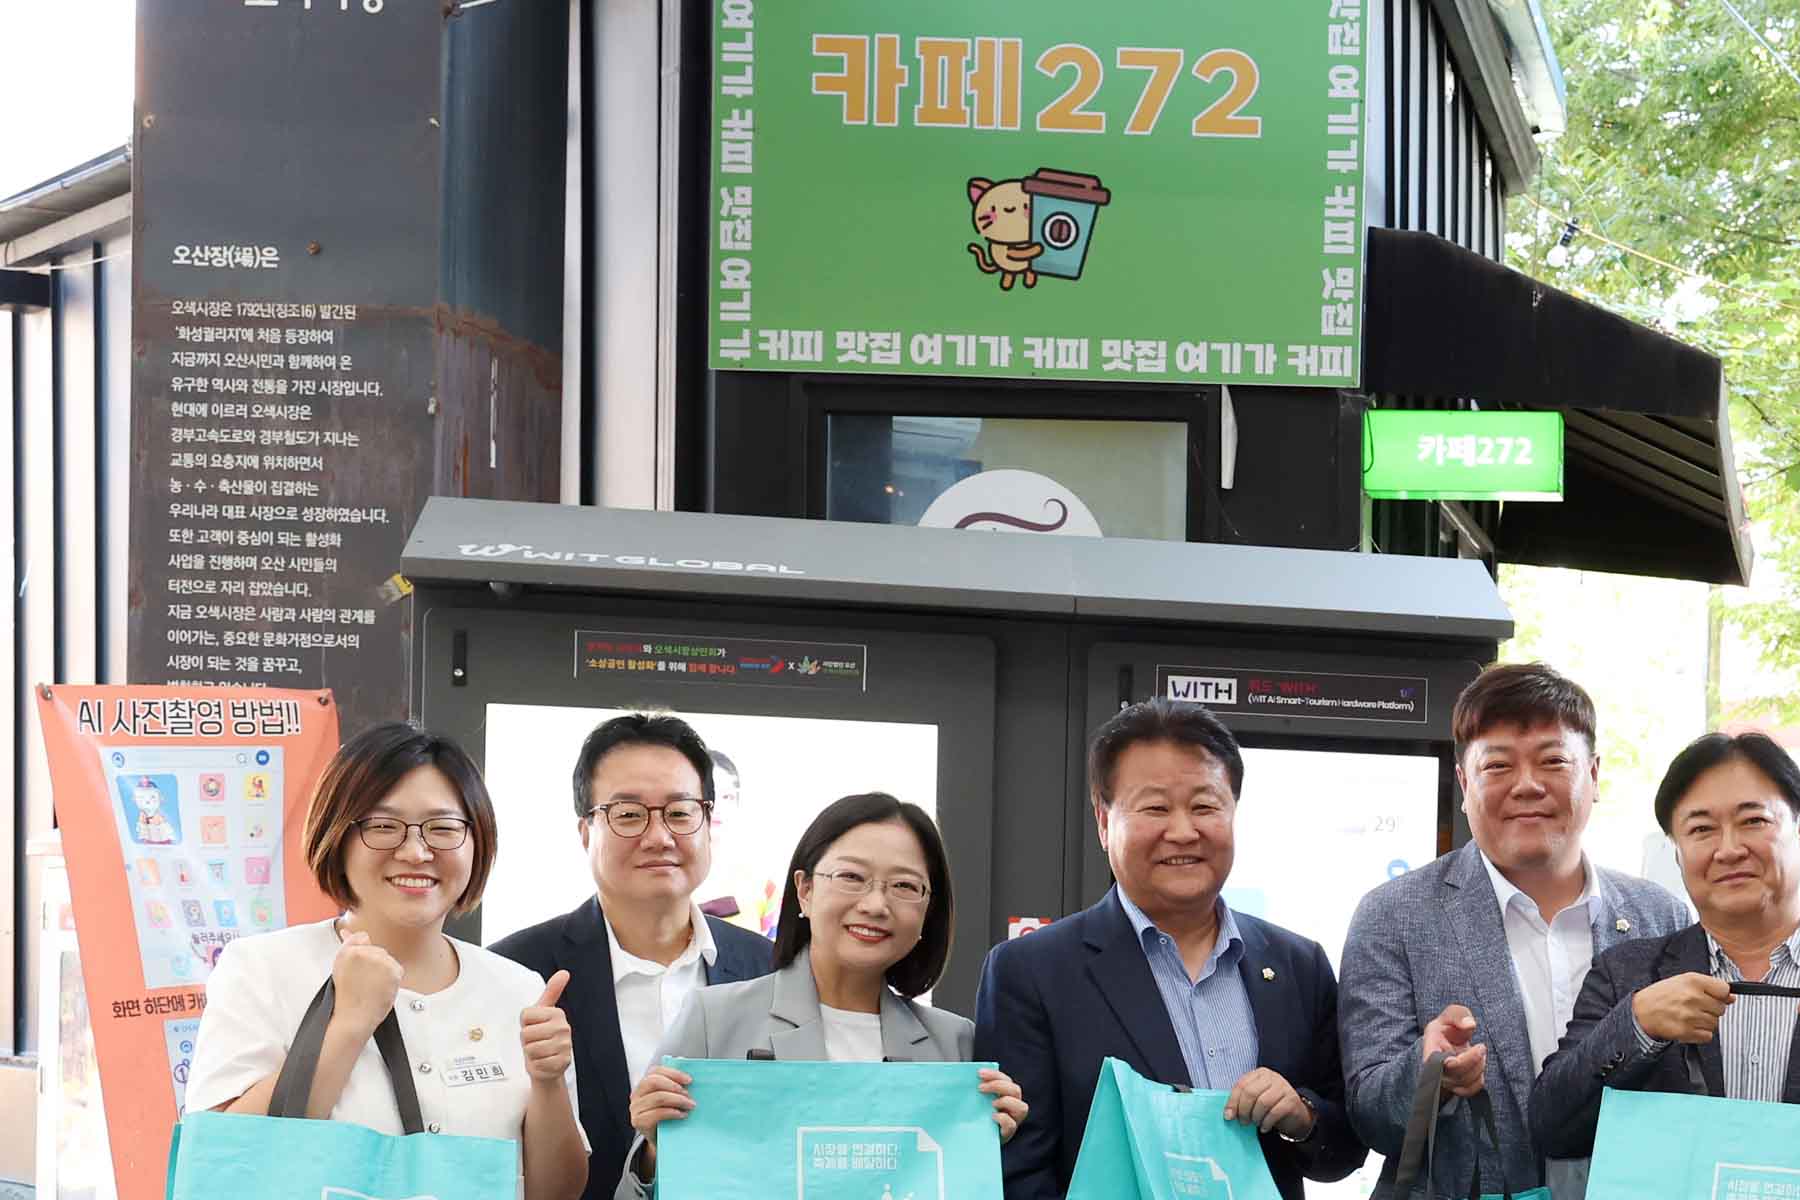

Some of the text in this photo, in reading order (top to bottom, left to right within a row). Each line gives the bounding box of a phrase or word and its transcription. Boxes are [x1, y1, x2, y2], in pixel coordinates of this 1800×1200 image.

[811, 33, 1262, 138] 카페272
[1327, 65, 1360, 173] 여기가
[721, 108, 753, 173] 커피
[720, 186, 752, 250] 맛집
[1323, 185, 1356, 254] 커피
[171, 300, 232, 317] 오색시장은
[320, 304, 356, 320] 발간된
[720, 258, 752, 360] 여기가
[1321, 268, 1355, 336] 맛집
[257, 328, 281, 343] 처음
[285, 329, 334, 344] 등장하여
[171, 352, 220, 367] 지금까지
[224, 353, 284, 369] 오산시민과
[288, 354, 336, 370] 함께하여
[758, 329, 1353, 378] 커피 맛집 여기가 커피 맛집 여기가 커피
[171, 378, 383, 397] 유구한 역사와 전통을 가진 시장입니다.
[171, 402, 312, 421] 현대에 이르러 오색시장은
[171, 428, 360, 447] 경부고속도로와 경부철도가 지나는
[1417, 434, 1533, 466] 카페272
[170, 453, 323, 471] 교통의 요충지에 위치하면서
[271, 481, 319, 497] 집결하는
[169, 503, 390, 524] 우리나라 대표 시장으로 성장하였습니다.
[169, 529, 341, 548] 또한 고객이 중심이 되는 활성화
[168, 554, 336, 573] 사업을 진행하며 오산 시민들의
[614, 555, 805, 575] GLOBAL
[168, 579, 312, 597] 터전으로 자리 잡았습니다.
[168, 604, 376, 625] 지금 오색시장은 사람과 사람의 관계를
[168, 630, 360, 649] 이어가는, 중요한 문화거점으로서의
[167, 655, 302, 674] 시장이 되는 것을 꿈꾸고,
[1170, 679, 1233, 700] WITH
[78, 700, 301, 736] AI 사진촬영 방법!!
[112, 999, 141, 1019] 화면
[144, 995, 185, 1015] 하단에
